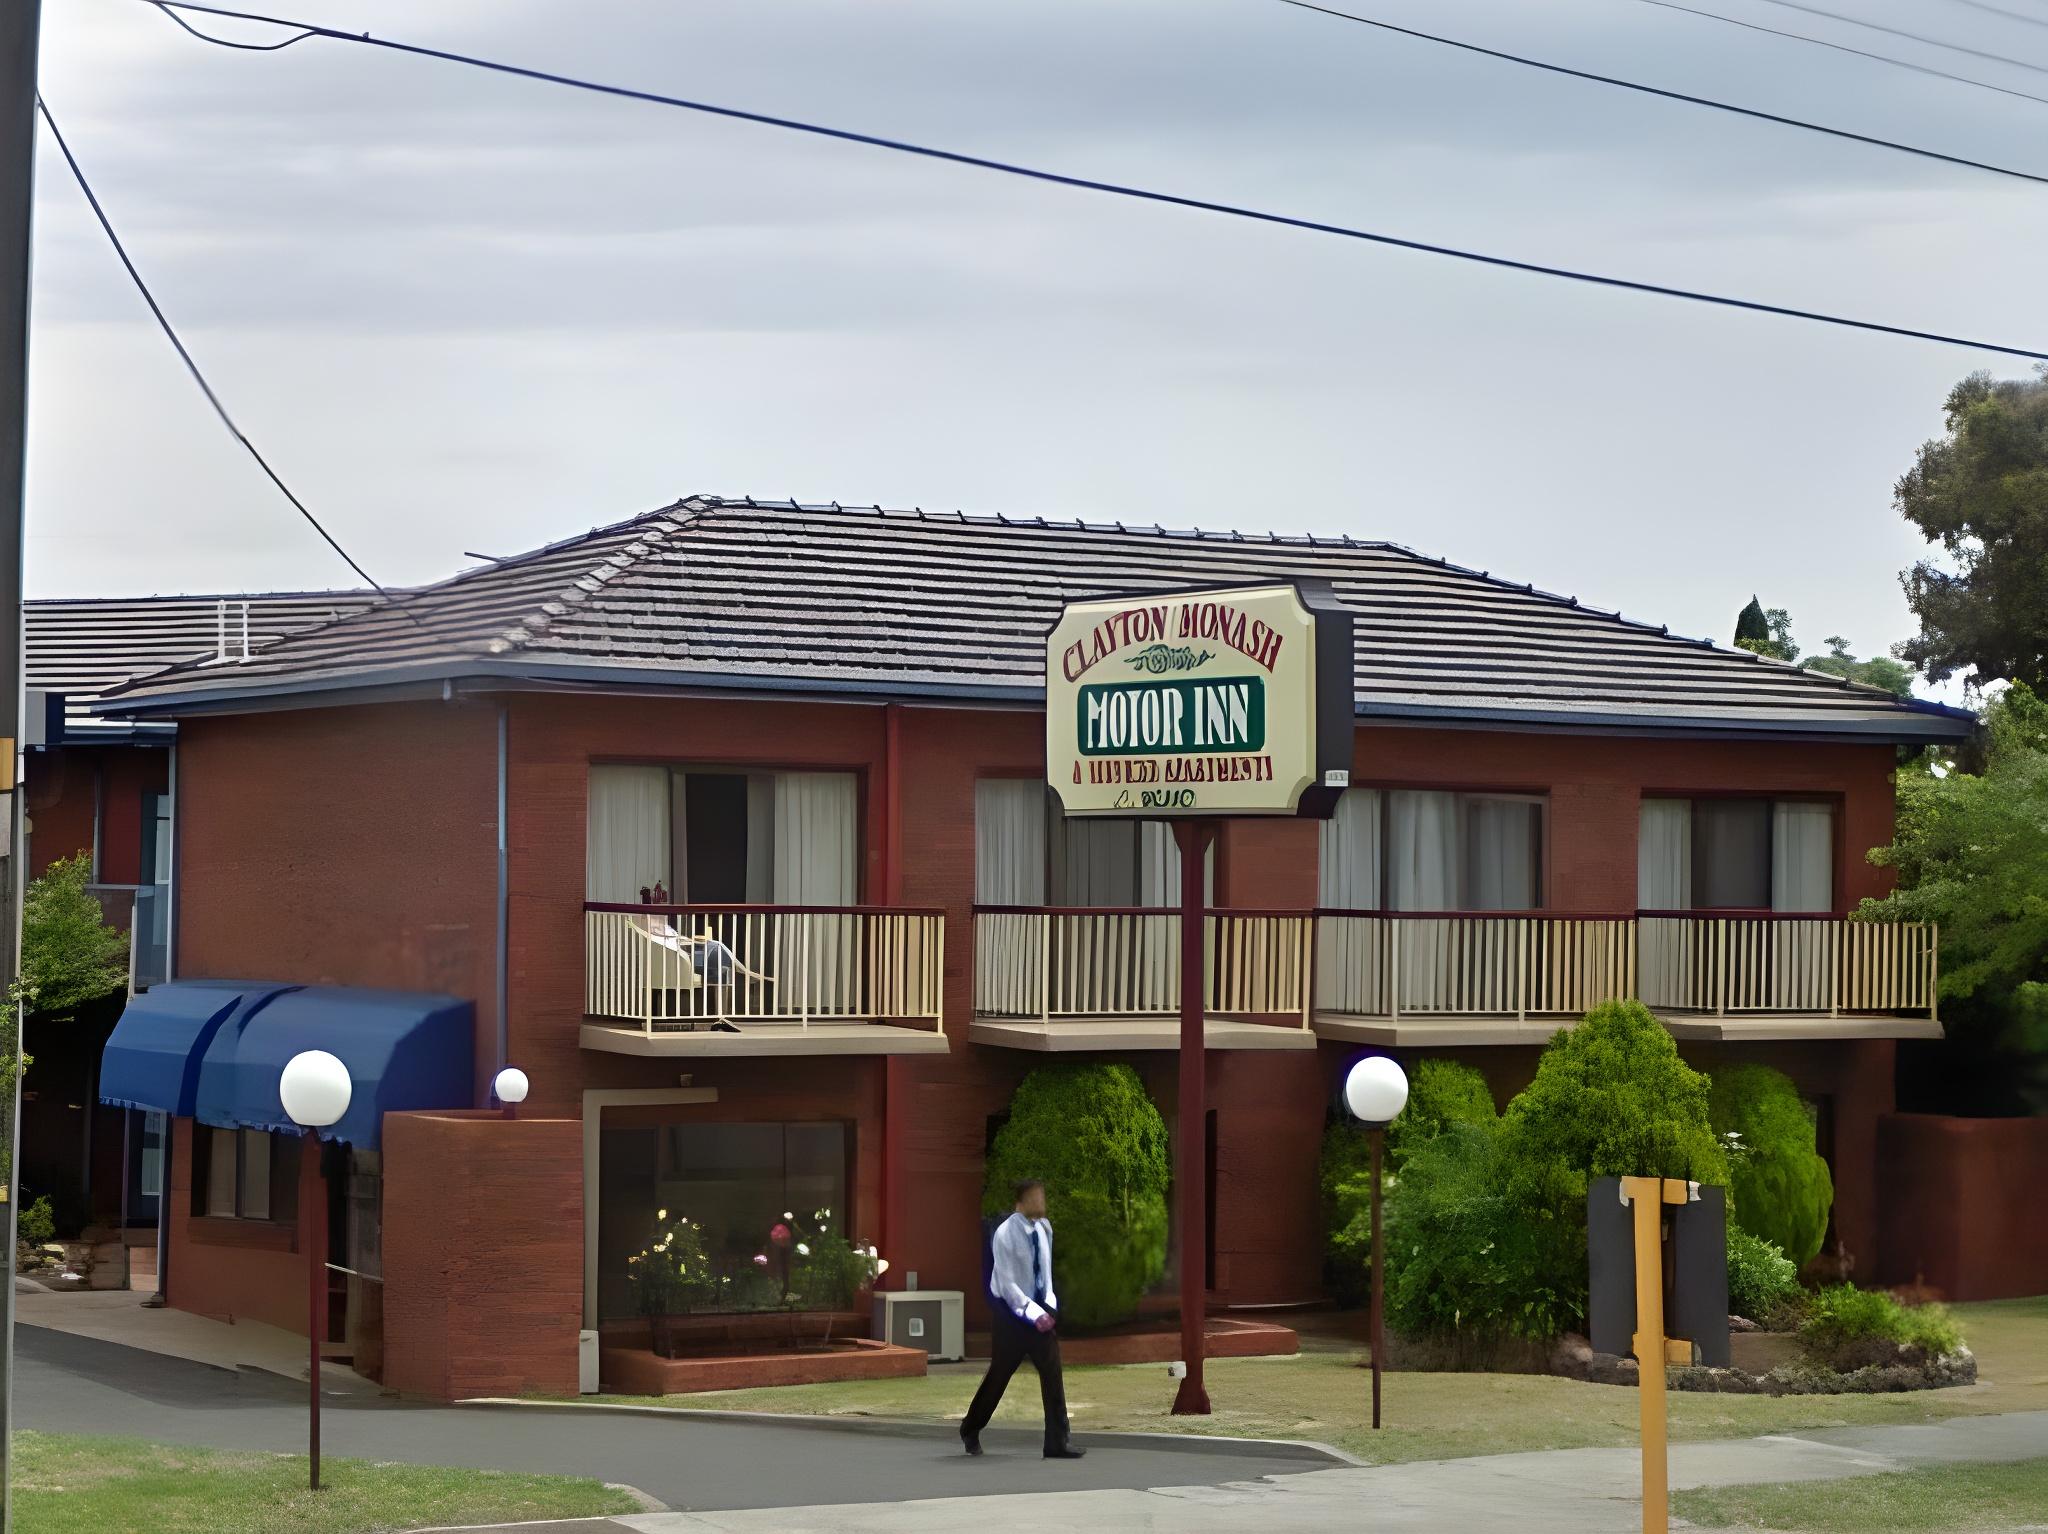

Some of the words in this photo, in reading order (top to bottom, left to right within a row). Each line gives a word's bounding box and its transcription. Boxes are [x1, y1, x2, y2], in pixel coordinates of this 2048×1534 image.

[1063, 605, 1168, 683] CLAYTON
[1087, 687, 1184, 749] MOTOR
[1194, 684, 1249, 746] INN
